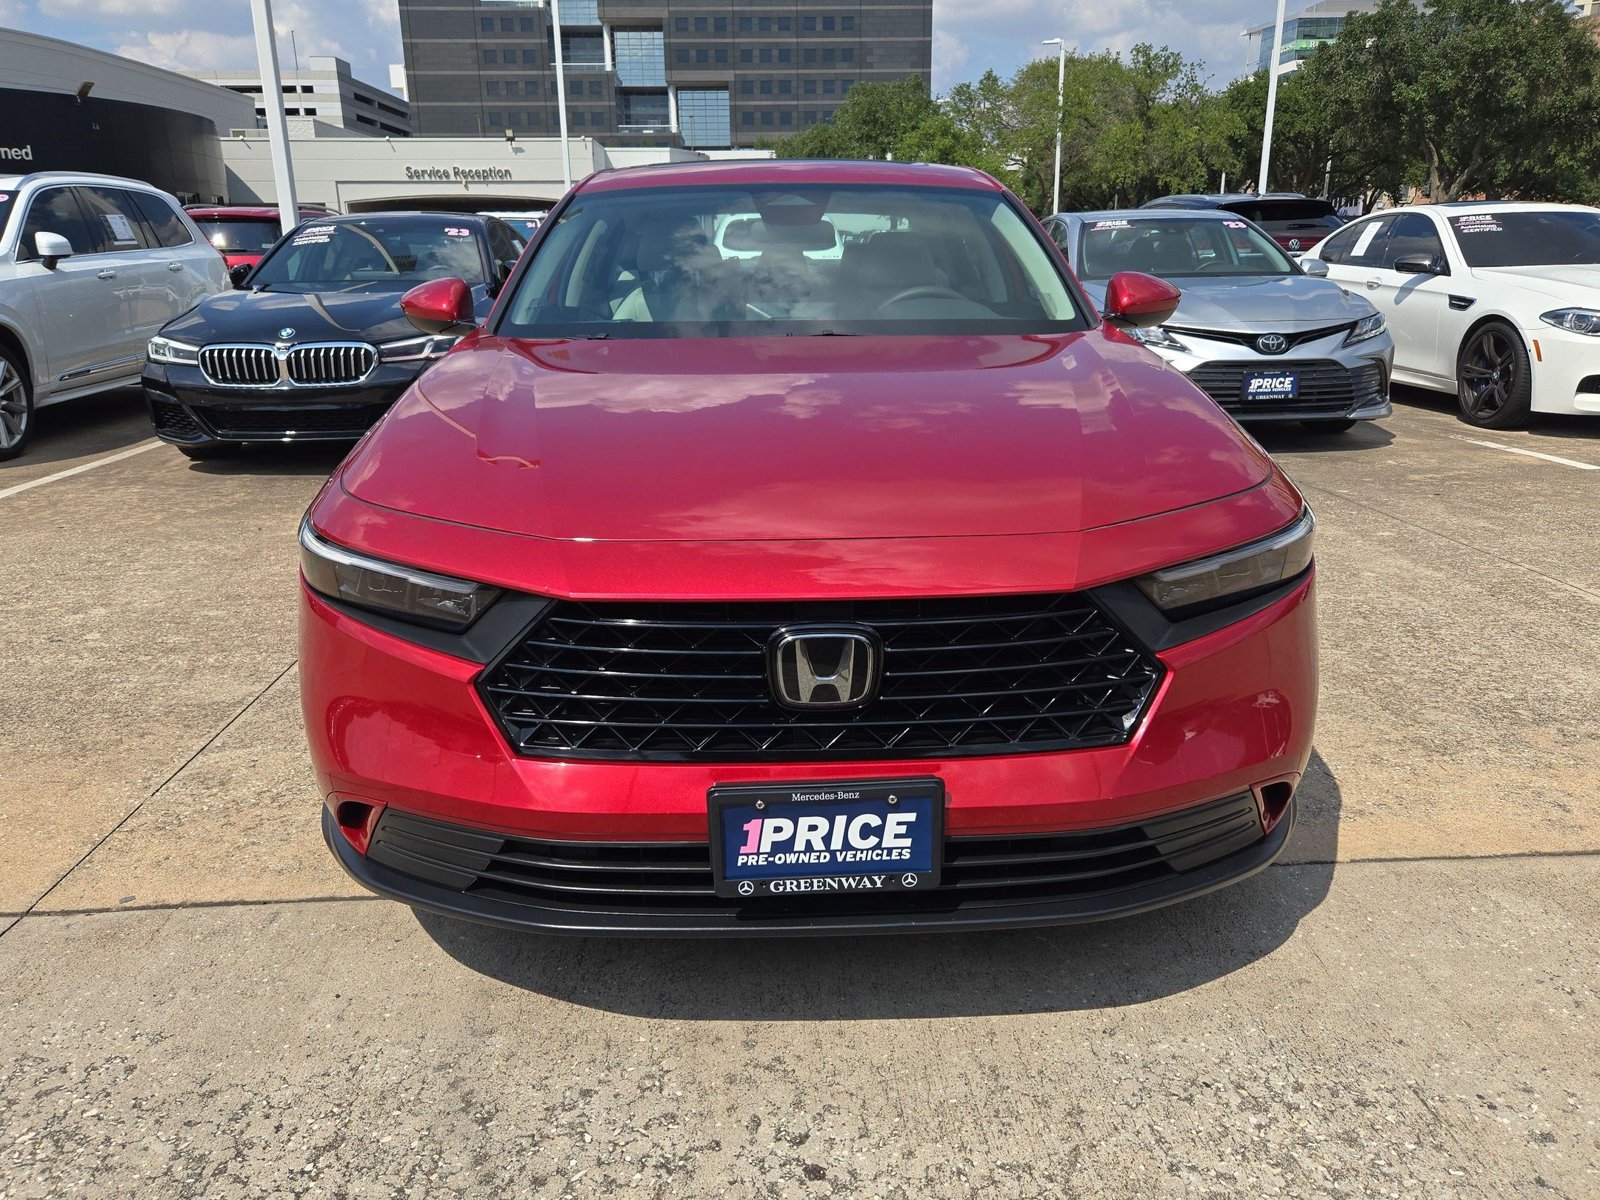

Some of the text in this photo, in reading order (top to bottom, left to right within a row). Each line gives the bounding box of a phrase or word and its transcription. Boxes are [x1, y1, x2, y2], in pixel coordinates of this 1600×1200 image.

[405, 166, 513, 181] Service Reception
[1249, 377, 1294, 389] 1PRICE
[791, 791, 860, 802] Mercedes-Benz
[739, 812, 917, 854] 1PRICE
[737, 849, 911, 867] PRE-OWNED VEHICLES
[769, 875, 886, 894] GREENWAY
